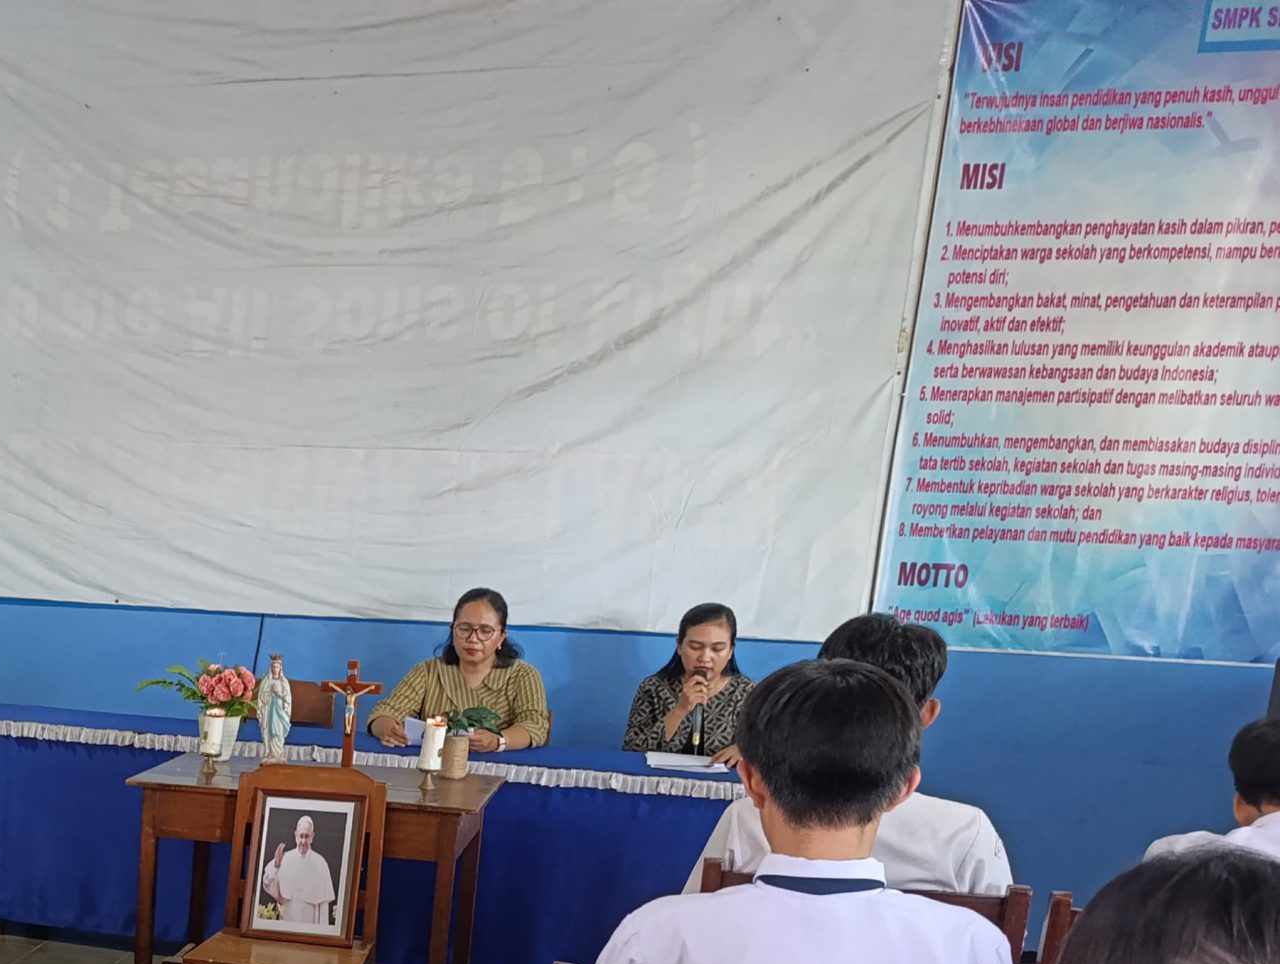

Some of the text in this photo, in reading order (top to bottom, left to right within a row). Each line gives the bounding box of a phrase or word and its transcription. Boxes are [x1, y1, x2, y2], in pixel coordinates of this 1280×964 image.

[1212, 6, 1280, 30] SMPK S
[981, 41, 1024, 73] VISI
[1039, 90, 1070, 108] insan
[1071, 88, 1133, 108] pendidikan
[1133, 90, 1163, 108] yang
[1163, 86, 1201, 107] penuh
[1201, 85, 1235, 105] kasih,
[958, 111, 1213, 137] berkebhinekaan global dan berjiwa nasionalis."
[960, 162, 1006, 190] MISI
[945, 220, 954, 238] 1.
[955, 219, 1084, 240] Menumbuhkembangkan
[1083, 218, 1156, 240] penghayatan
[1157, 218, 1188, 236] kasih
[1189, 217, 1225, 235] dalam
[1224, 217, 1266, 237] pikiran,
[940, 244, 950, 262] 2.
[951, 244, 1019, 263] Menciptakan
[1019, 247, 1054, 265] warga
[1054, 244, 1098, 261] sekolah
[1098, 246, 1127, 265] yang
[1127, 243, 1213, 264] berkompetensi,
[1215, 246, 1258, 264] mampu
[946, 268, 1010, 289] potensi diri;
[932, 291, 943, 309] 3.
[944, 291, 1035, 312] Mengembangkan
[1035, 291, 1068, 311] bakat,
[1069, 292, 1103, 311] minat,
[1103, 291, 1178, 313] pengetahuan
[1178, 291, 1201, 309] dan
[1201, 291, 1275, 313] keterampilan
[939, 315, 1067, 335] inovatif, aktif dan efektif;
[925, 338, 936, 356] 4.
[936, 338, 1009, 359] Menghasilkan
[1010, 340, 1050, 356] lulusan
[1051, 342, 1080, 360] yang
[1079, 339, 1126, 357] memiliki
[1125, 339, 1191, 361] keunggulan
[1192, 341, 1247, 359] akademik
[932, 363, 1219, 384] serta berwawasan kebangsaan dan budaya Indonesia;
[919, 384, 928, 402] 5.
[929, 385, 994, 406] Menerapkan
[994, 388, 1056, 407] manajemen
[1056, 388, 1115, 408] partisipatif
[1114, 389, 1157, 409] dengan
[1157, 389, 1218, 407] melibatkan
[1219, 389, 1263, 407] seluruh
[926, 410, 955, 427] solid;
[911, 431, 921, 448] 6.
[922, 431, 1000, 449] Menumbuhkan,
[1002, 433, 1097, 454] mengembangkan,
[1099, 435, 1121, 452] dan
[1121, 436, 1197, 453] membiasakan
[1198, 437, 1241, 458] budaya
[918, 455, 939, 471] tata
[939, 455, 967, 471] tertib
[967, 457, 1011, 473] sekolah,
[1012, 457, 1058, 477] kegiatan
[1059, 458, 1102, 475] sekolah
[1102, 459, 1125, 475] dan
[1126, 460, 1157, 479] tugas
[1158, 463, 1243, 482] masing-masing
[905, 476, 913, 492] 7.
[915, 477, 976, 495] Membentuk
[976, 480, 1038, 497] kepribadian
[1039, 483, 1073, 500] warga
[1073, 482, 1117, 499] sekolah
[1116, 486, 1145, 503] yang
[1146, 484, 1210, 502] berkarakter
[1210, 486, 1253, 506] religius,
[911, 502, 1104, 522] royong melalui kegiatan sekolah; dan
[898, 521, 907, 538] 8.
[908, 521, 971, 540] Memberikan
[971, 525, 1026, 545] pelayanan
[1026, 527, 1049, 543] dan
[1048, 528, 1077, 544] mutu
[1077, 528, 1138, 547] pendidikan
[1137, 532, 1168, 551] yang
[1166, 530, 1193, 548] baik
[1192, 531, 1235, 552] kepada
[898, 562, 969, 589] MOTTO
[914, 608, 940, 623] quod
[942, 608, 969, 627] agis"
[1021, 615, 1047, 632] yang
[1049, 614, 1089, 632] terbaik)
